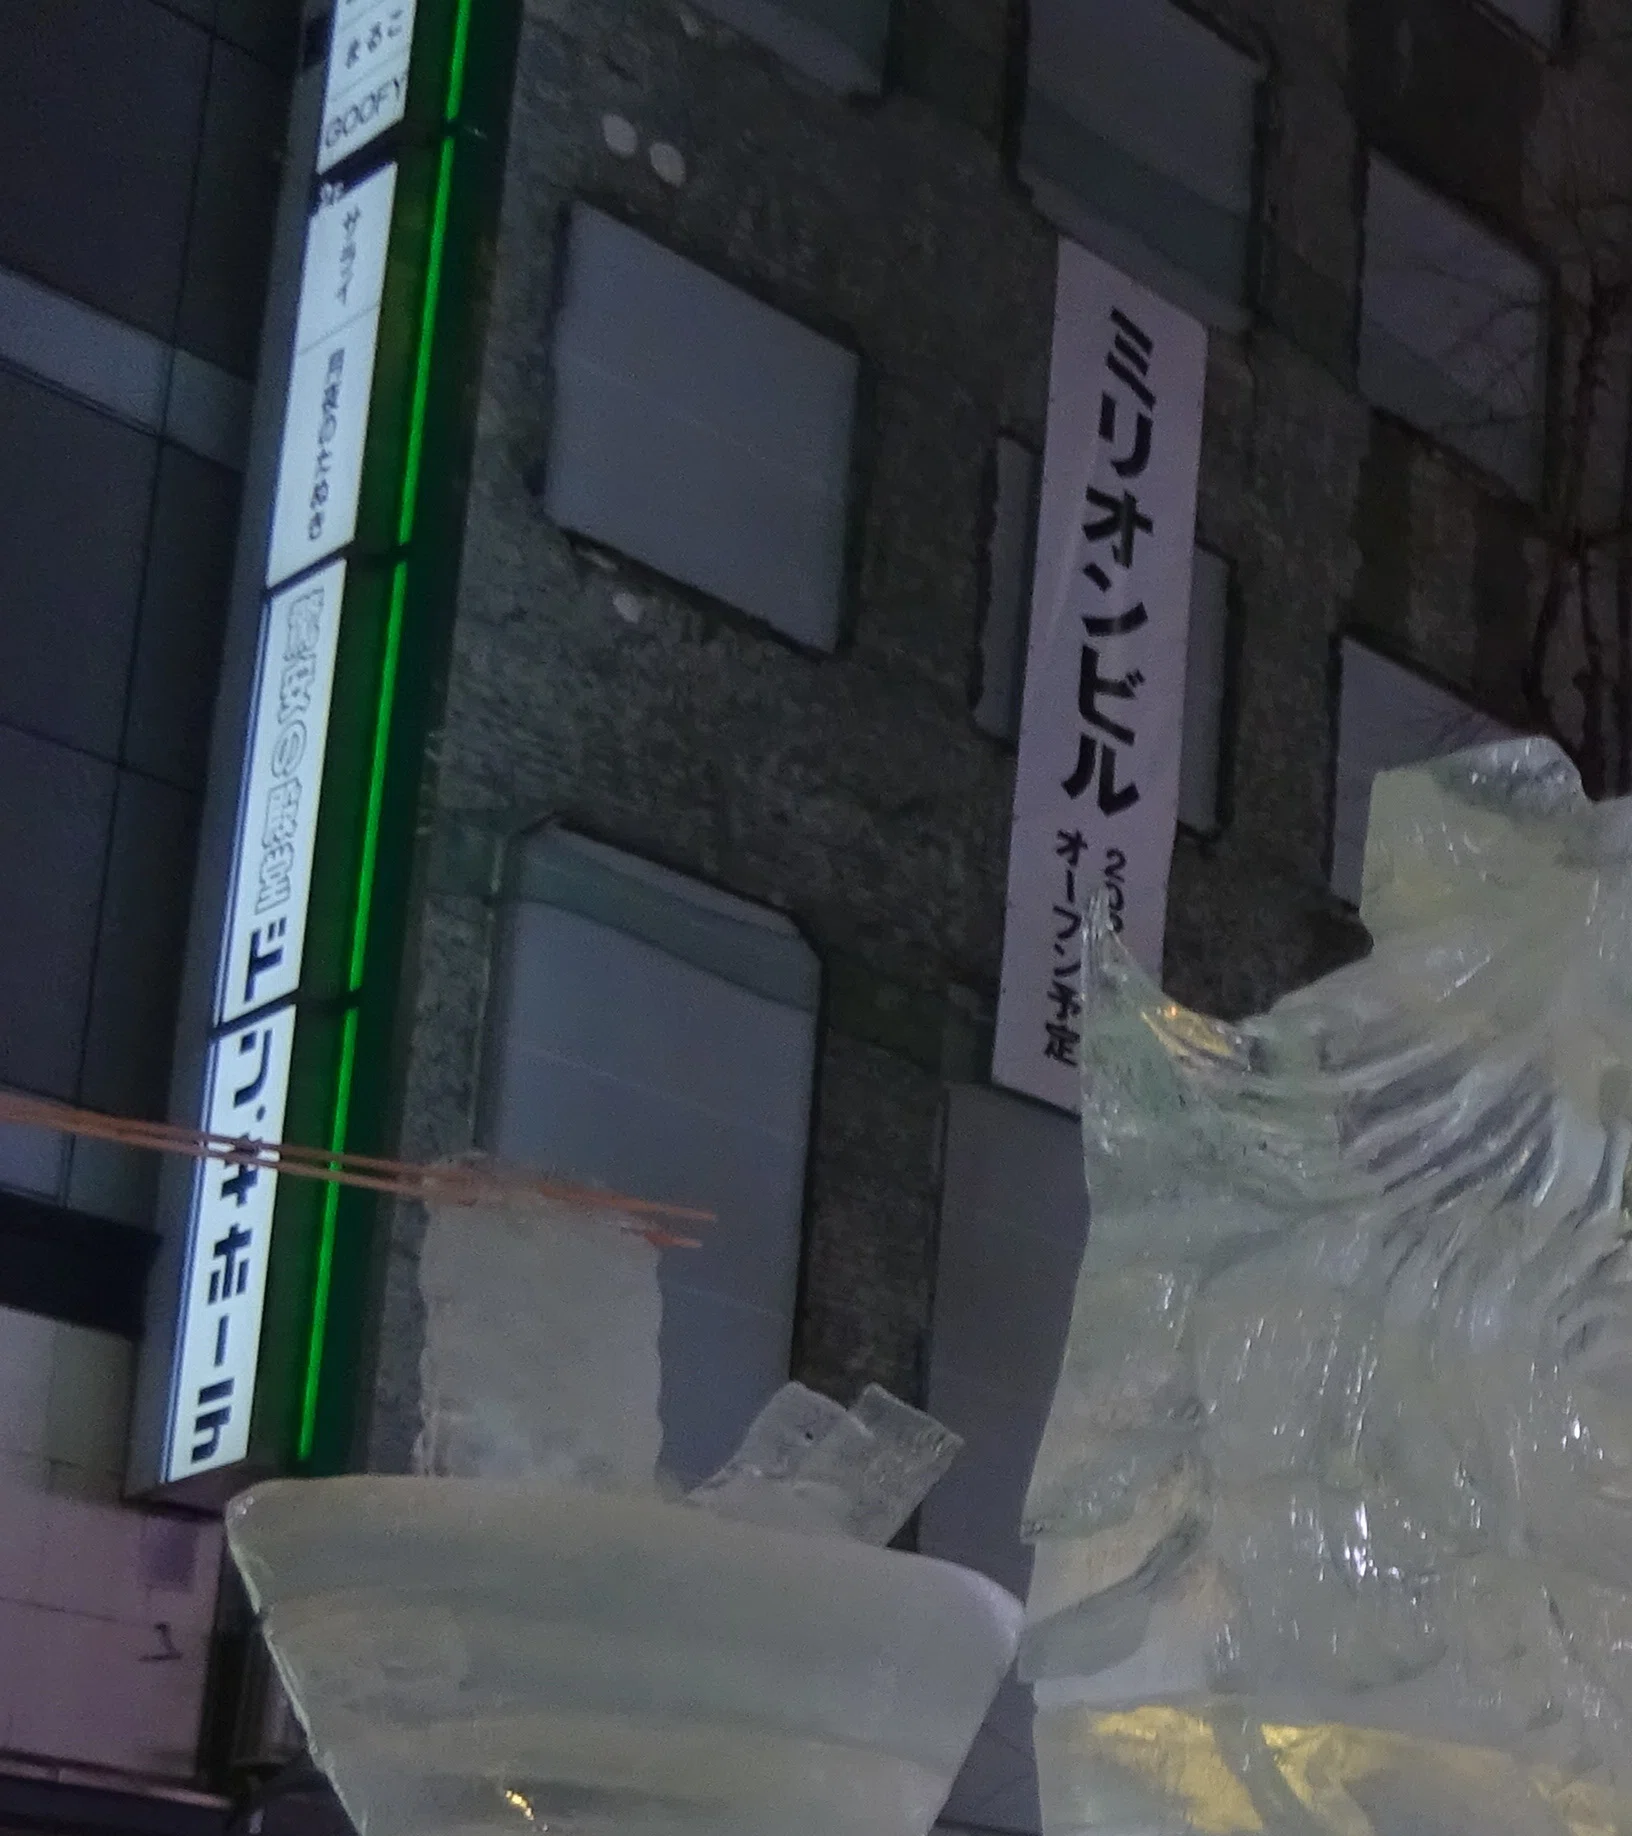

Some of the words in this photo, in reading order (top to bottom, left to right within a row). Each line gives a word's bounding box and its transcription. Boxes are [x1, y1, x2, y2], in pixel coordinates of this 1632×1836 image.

[1062, 307, 1156, 818] ミリオンビル
[190, 915, 288, 1464] ドン・キホーテ
